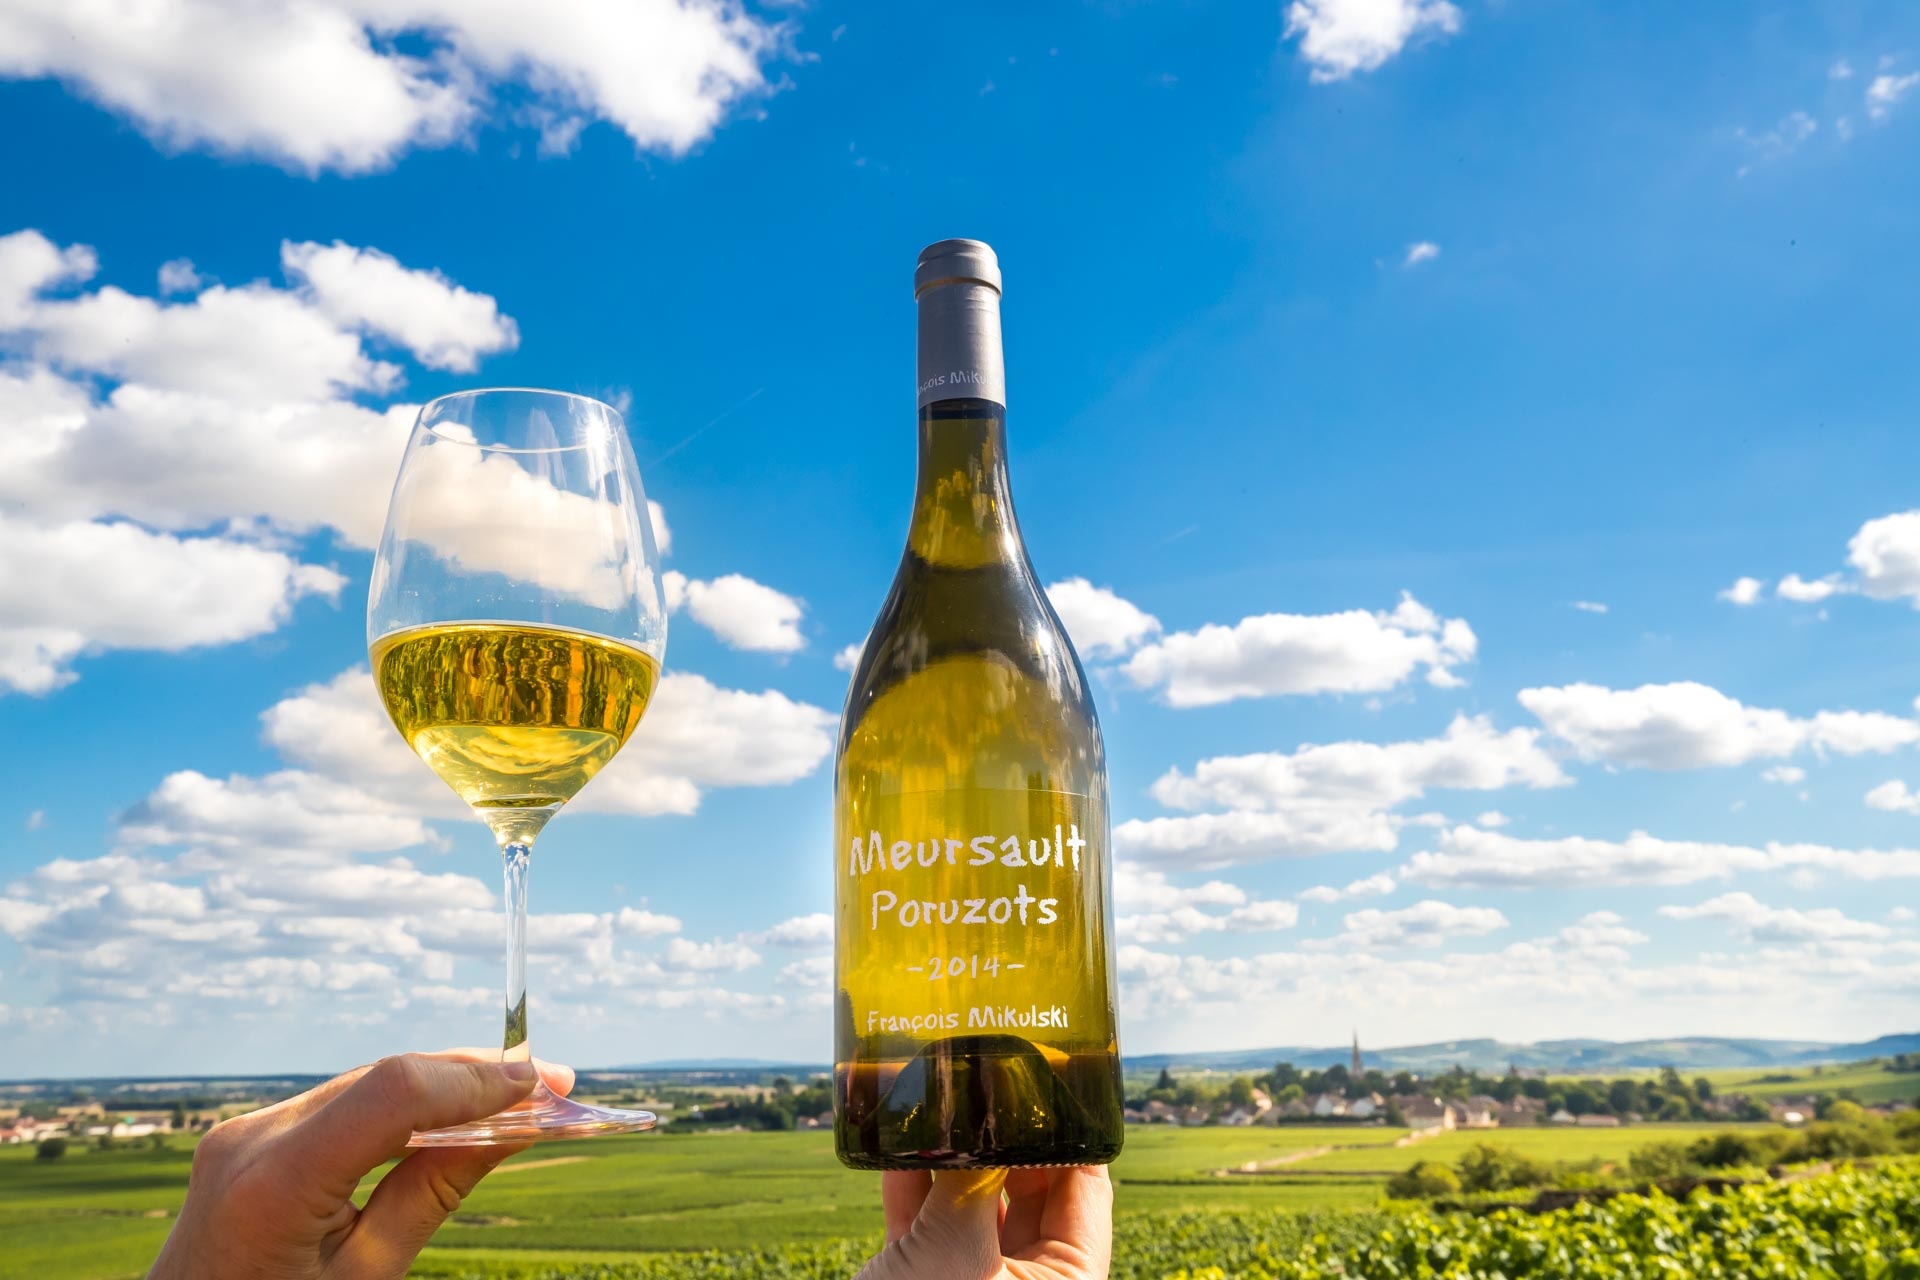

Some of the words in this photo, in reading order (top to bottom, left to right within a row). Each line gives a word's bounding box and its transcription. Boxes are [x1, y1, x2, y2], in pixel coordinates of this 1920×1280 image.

[918, 374, 945, 395] nçois
[850, 824, 1086, 876] Meursault
[871, 884, 1058, 930] Poruzots
[867, 1008, 959, 1033] François
[968, 1004, 1069, 1028] Mikulski
